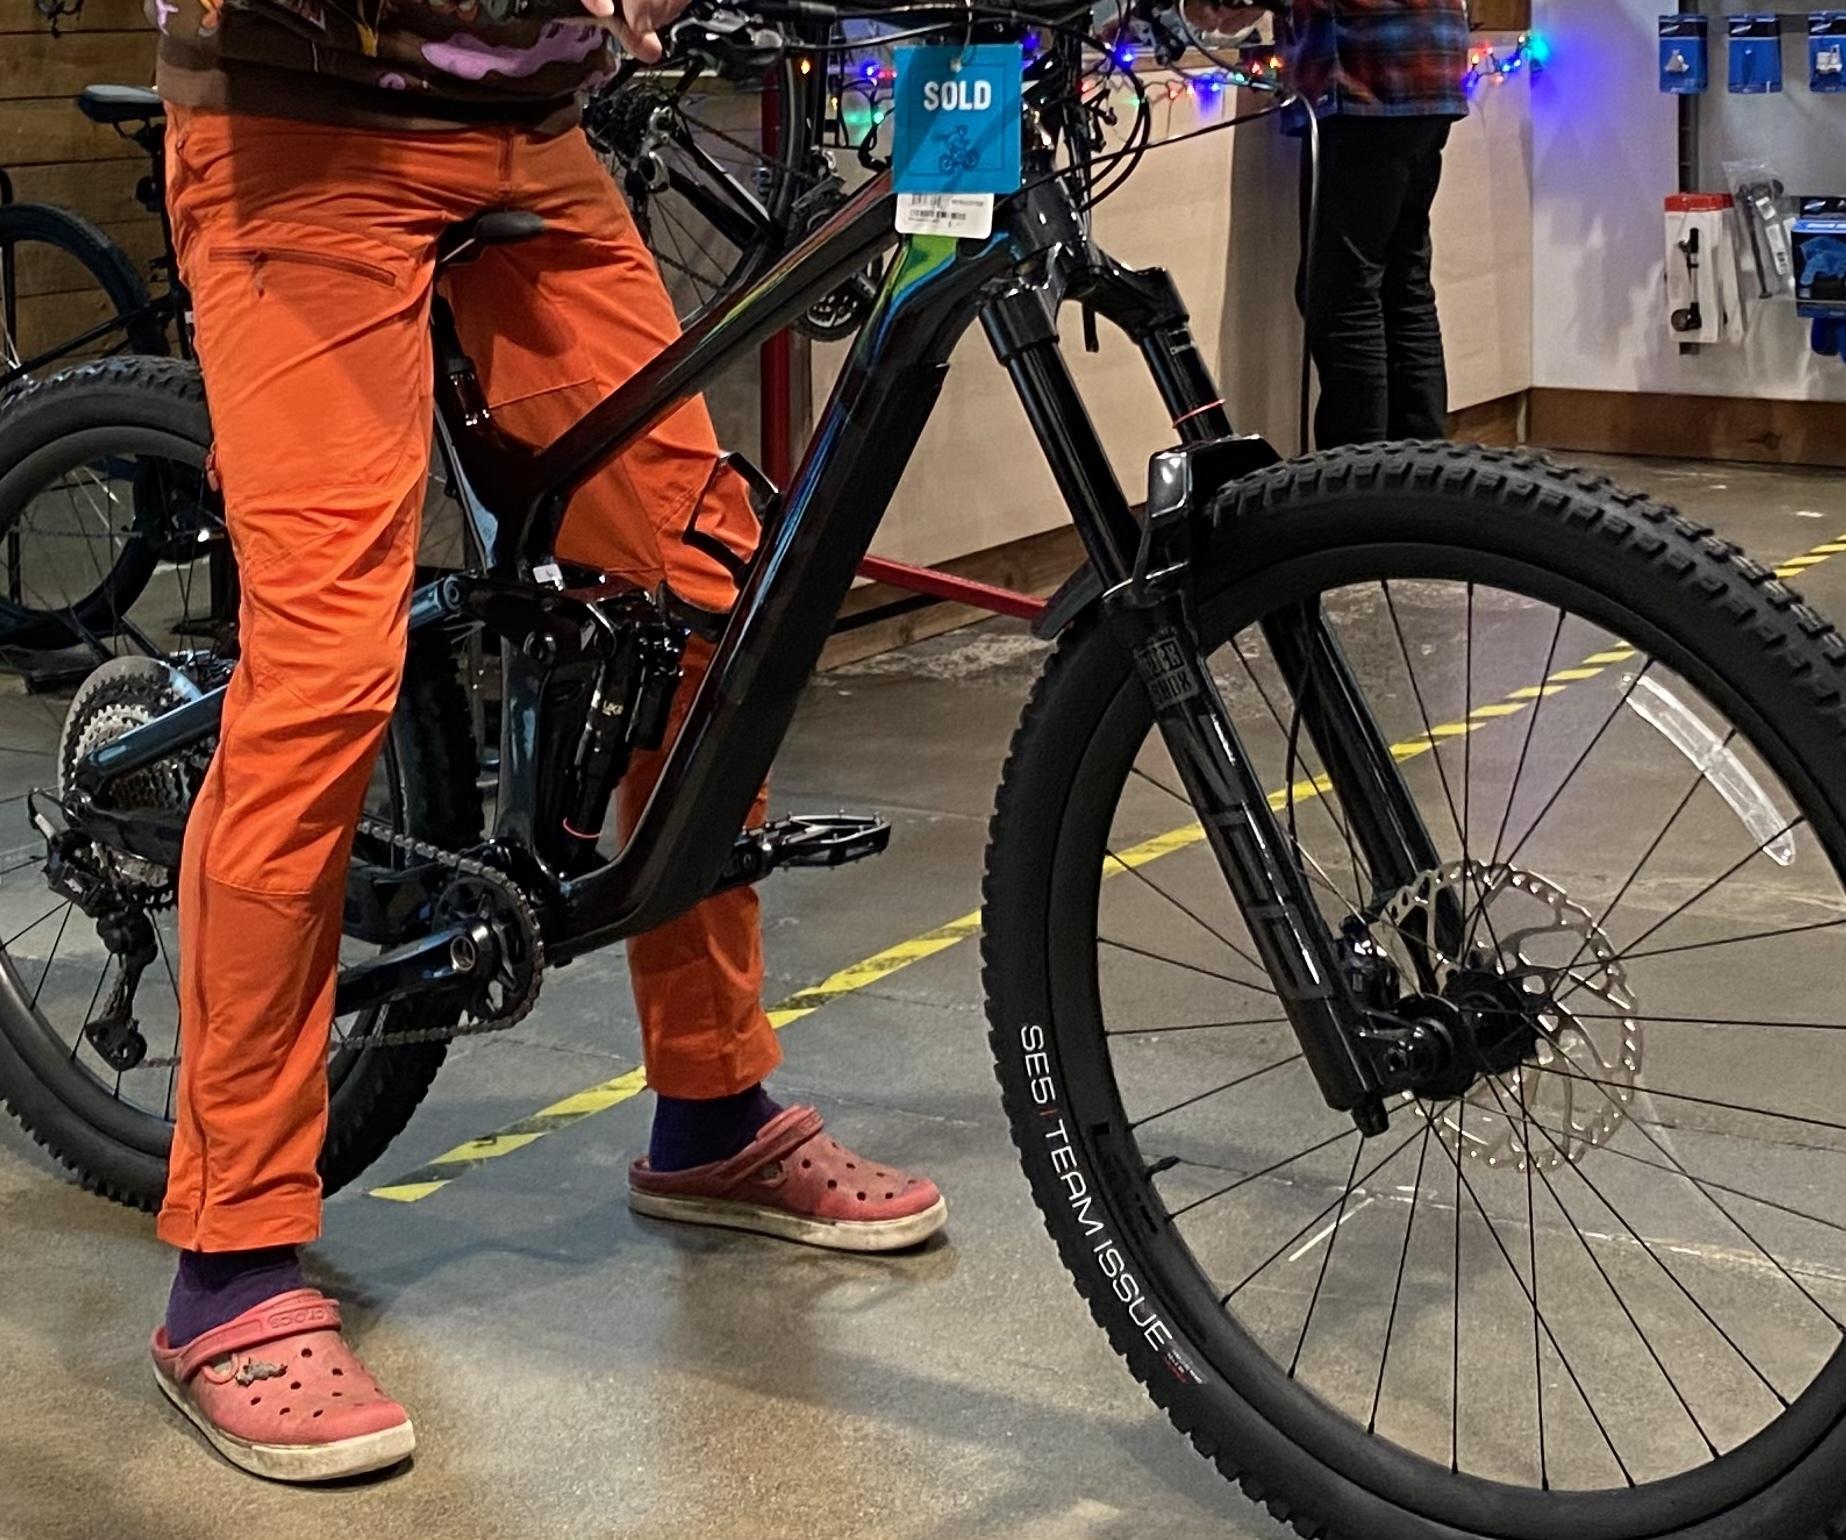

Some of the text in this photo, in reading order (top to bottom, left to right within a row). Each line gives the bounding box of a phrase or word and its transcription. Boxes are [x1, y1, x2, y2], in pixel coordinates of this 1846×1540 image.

[923, 80, 992, 111] SOLD
[1020, 1024, 1174, 1352] SE5 TEAM ISSUE
